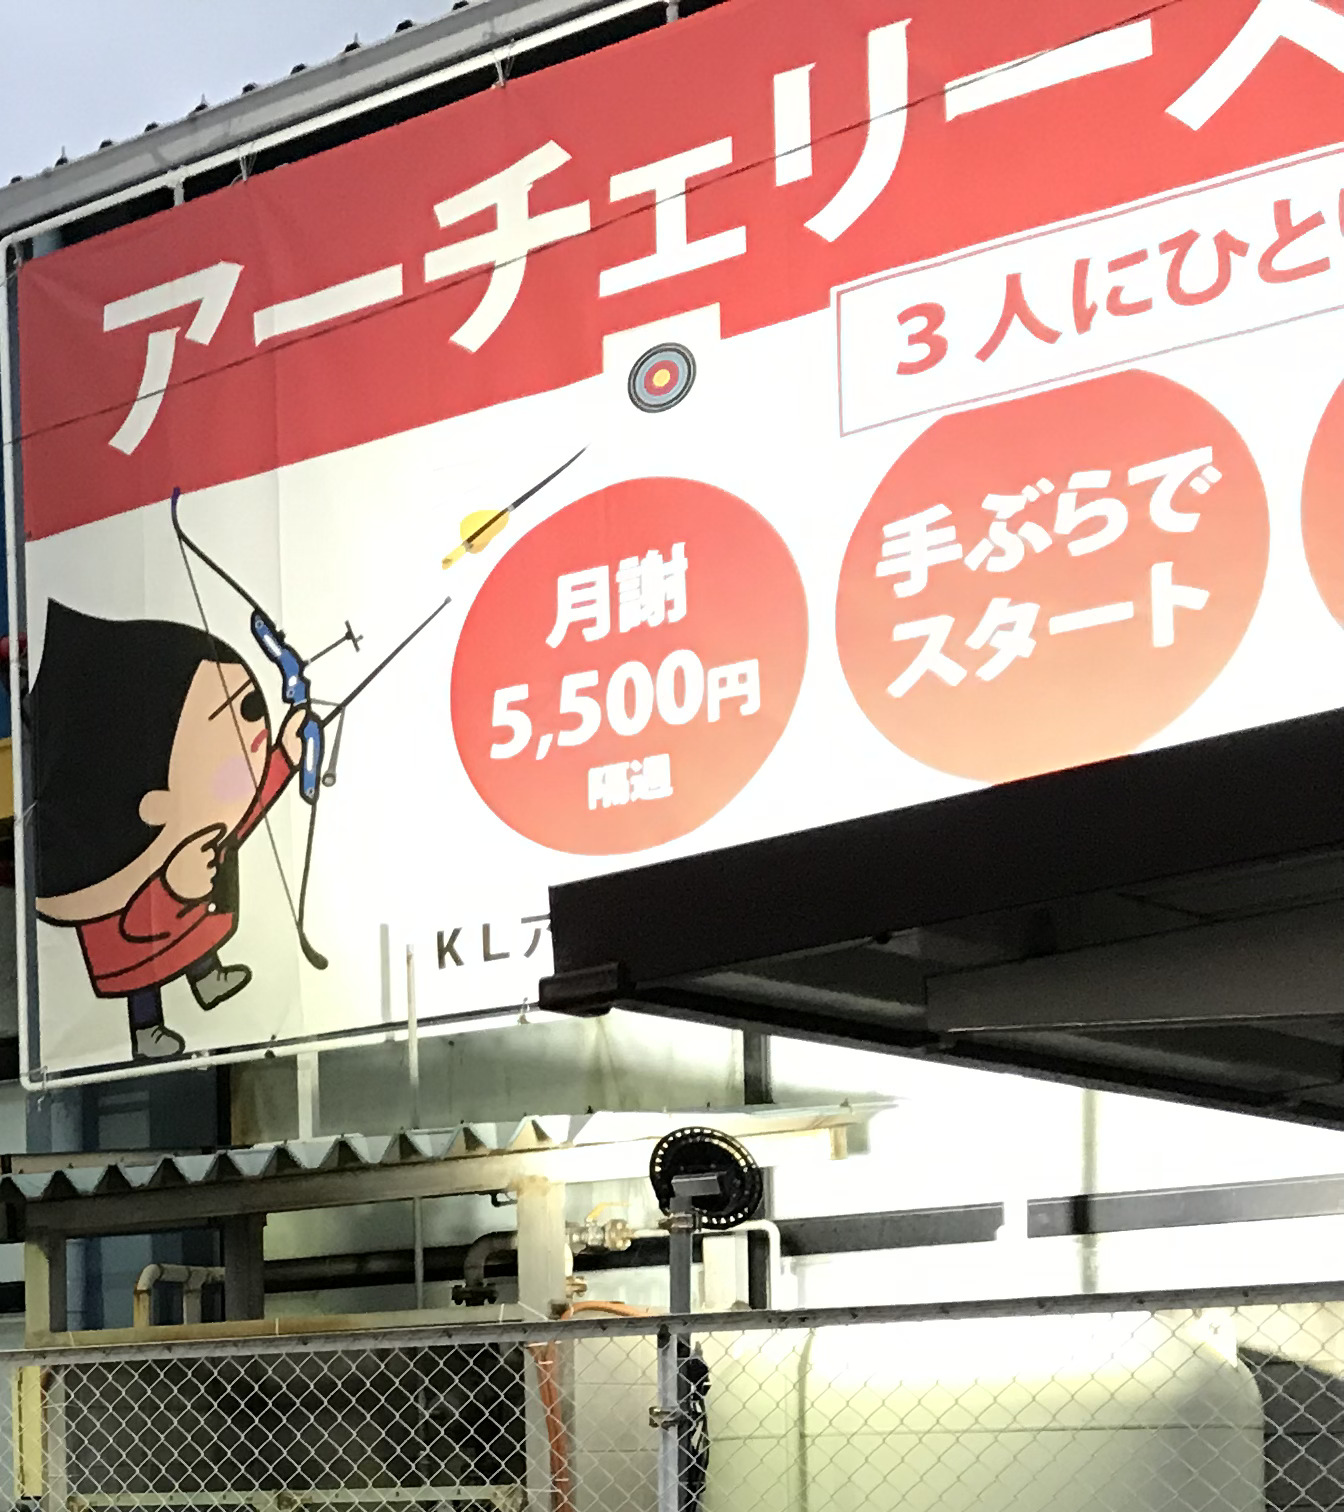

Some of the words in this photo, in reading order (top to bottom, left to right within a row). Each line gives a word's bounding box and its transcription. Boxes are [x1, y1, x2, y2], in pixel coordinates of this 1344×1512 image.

[896, 188, 1344, 375] 3人にひと
[875, 446, 1223, 598] 手ぶらで
[545, 541, 688, 648] 月謝
[887, 561, 1210, 698] スタート
[489, 649, 761, 760] 5,500円
